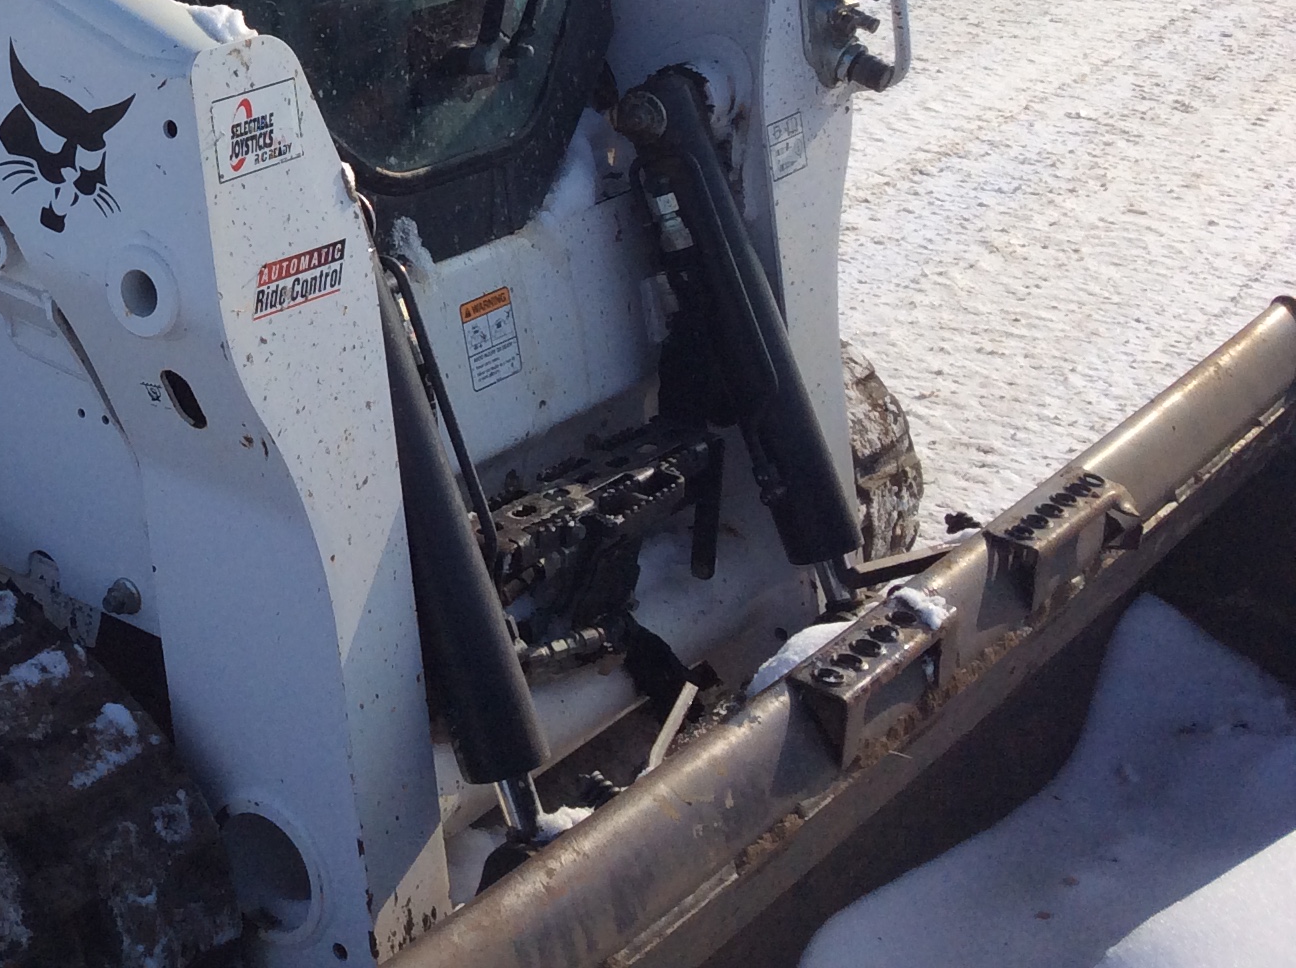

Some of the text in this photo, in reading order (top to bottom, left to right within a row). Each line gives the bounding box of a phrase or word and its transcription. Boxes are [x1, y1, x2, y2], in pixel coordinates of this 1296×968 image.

[230, 112, 274, 140] SELECTABLE
[229, 128, 275, 162] JOYSTICKS
[260, 243, 343, 285] AUTOMATIC
[254, 262, 344, 315] Ride Control
[471, 292, 507, 314] WARNING
